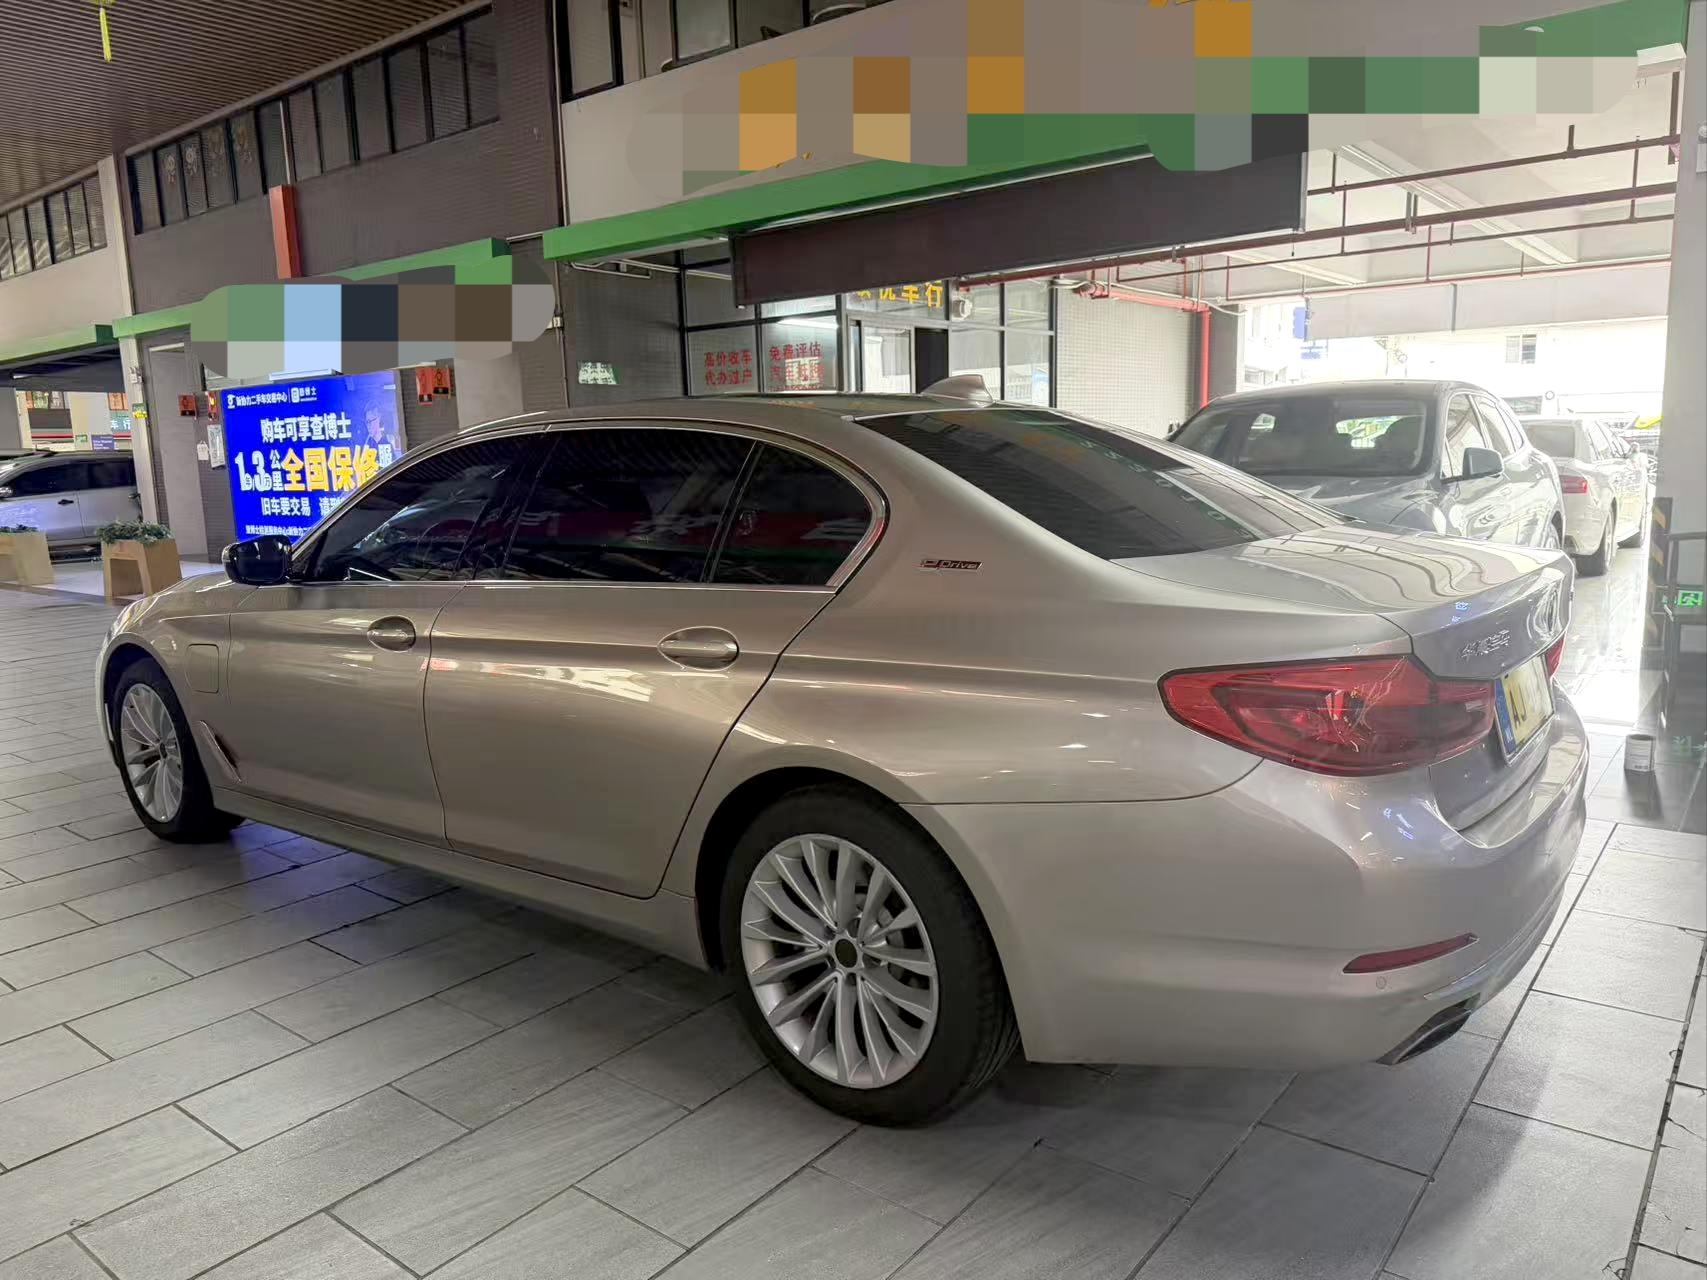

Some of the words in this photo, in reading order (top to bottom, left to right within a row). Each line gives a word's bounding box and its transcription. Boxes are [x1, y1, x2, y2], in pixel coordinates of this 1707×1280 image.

[260, 412, 352, 443] 购车可享查博士
[261, 496, 311, 517] 旧车要交易
